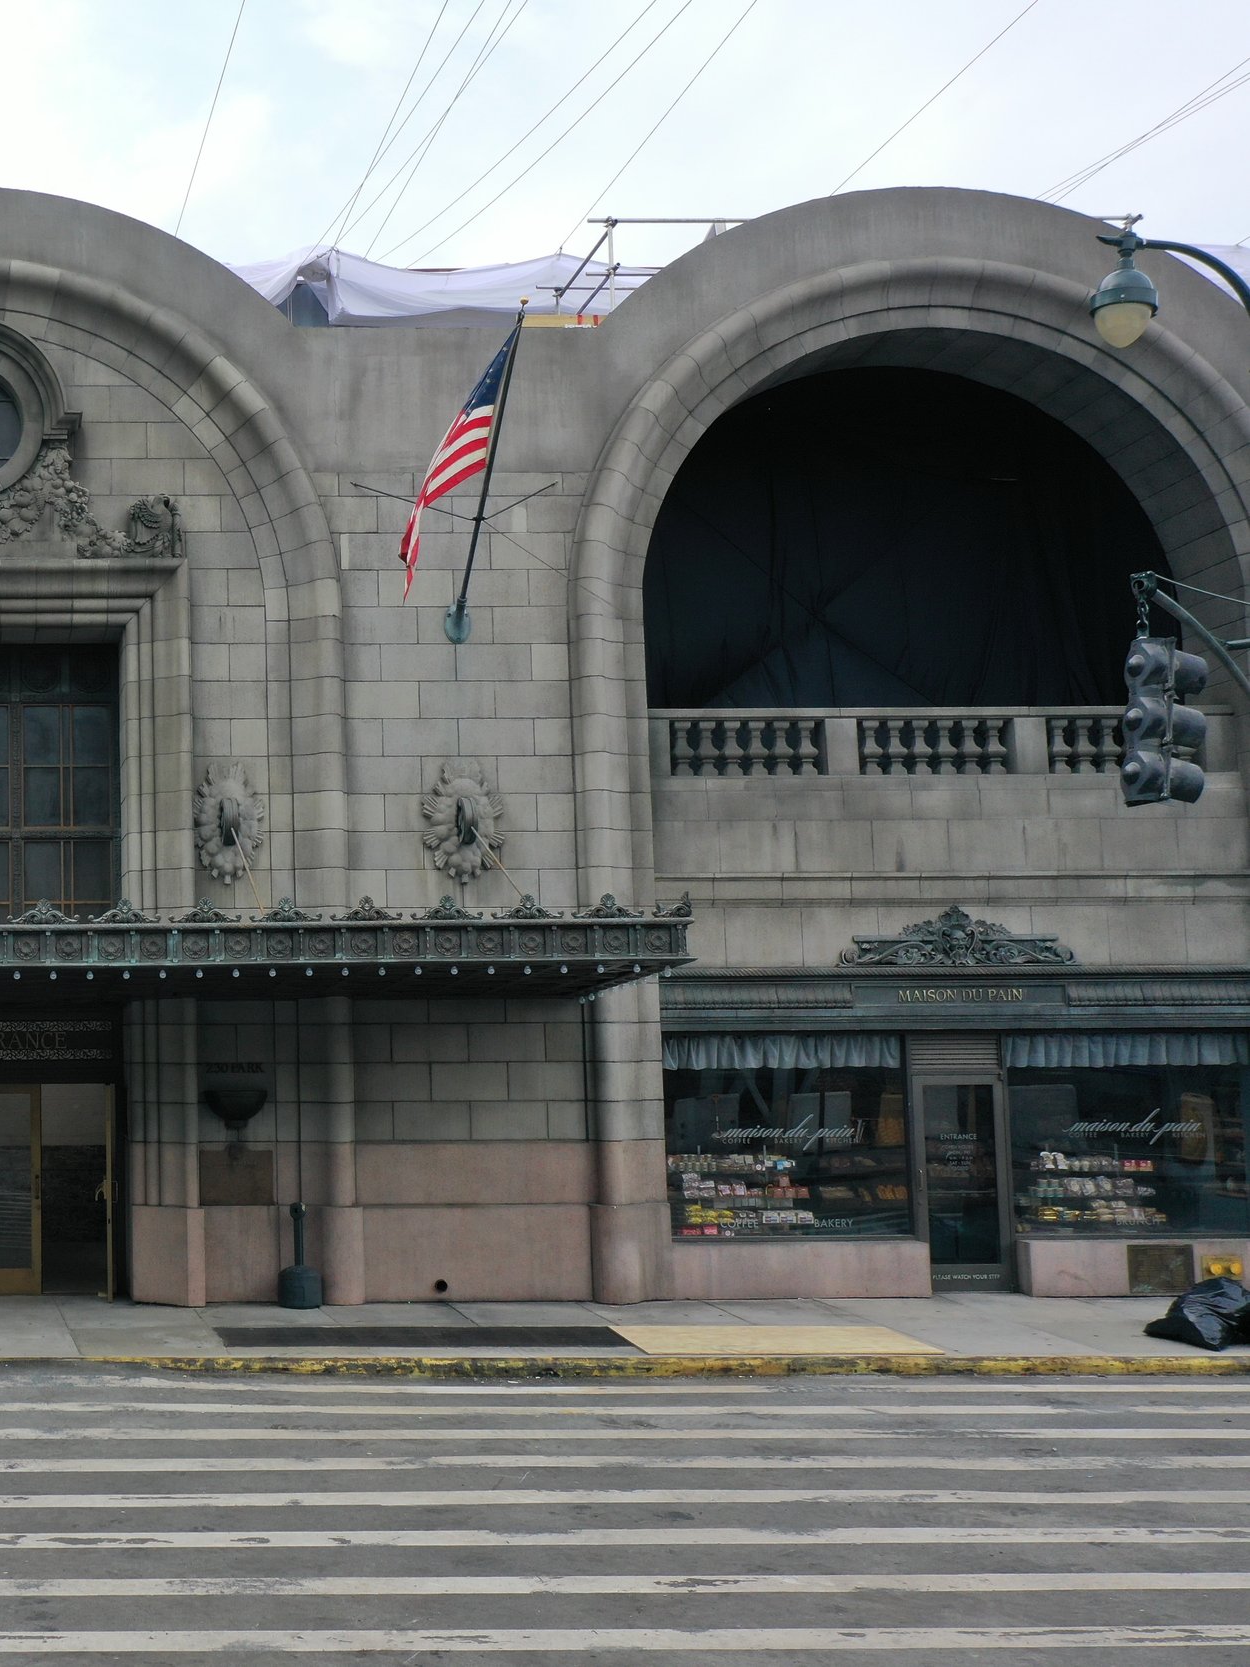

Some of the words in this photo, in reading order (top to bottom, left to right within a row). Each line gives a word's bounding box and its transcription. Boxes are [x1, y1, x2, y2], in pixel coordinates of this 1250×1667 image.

[897, 989, 957, 1002] MAISON
[962, 988, 983, 1001] DU
[988, 988, 1023, 1001] PAIN
[230, 1062, 266, 1074] PARK
[1062, 1118, 1131, 1133] maison
[1129, 1107, 1160, 1133] du
[1150, 1119, 1202, 1146] pain
[715, 1124, 784, 1139] maison
[803, 1124, 857, 1151] pain
[722, 1137, 751, 1145] COFFEE
[774, 1137, 803, 1145] BAKERY
[825, 1136, 861, 1144] KITCHEN
[720, 1218, 759, 1228] COFFEE
[814, 1218, 854, 1228] BAKERY
[1116, 1216, 1160, 1226] BRUNCH
